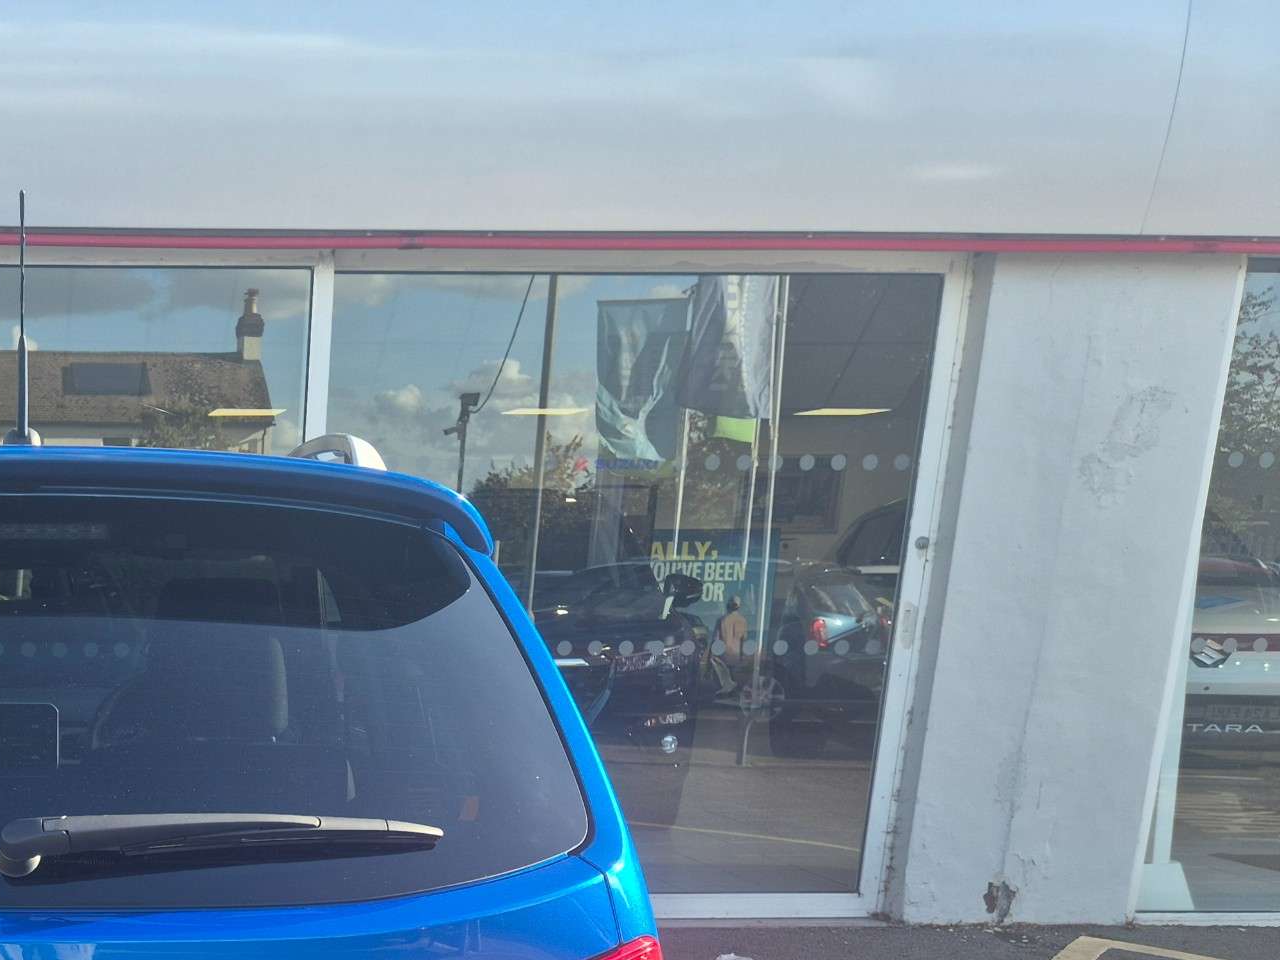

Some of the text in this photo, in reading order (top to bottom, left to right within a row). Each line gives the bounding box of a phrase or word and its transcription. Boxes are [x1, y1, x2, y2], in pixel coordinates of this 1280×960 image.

[651, 541, 718, 560] ALLY,
[704, 561, 746, 581] BEEN
[702, 582, 725, 602] OR
[1186, 723, 1264, 734] TARA
